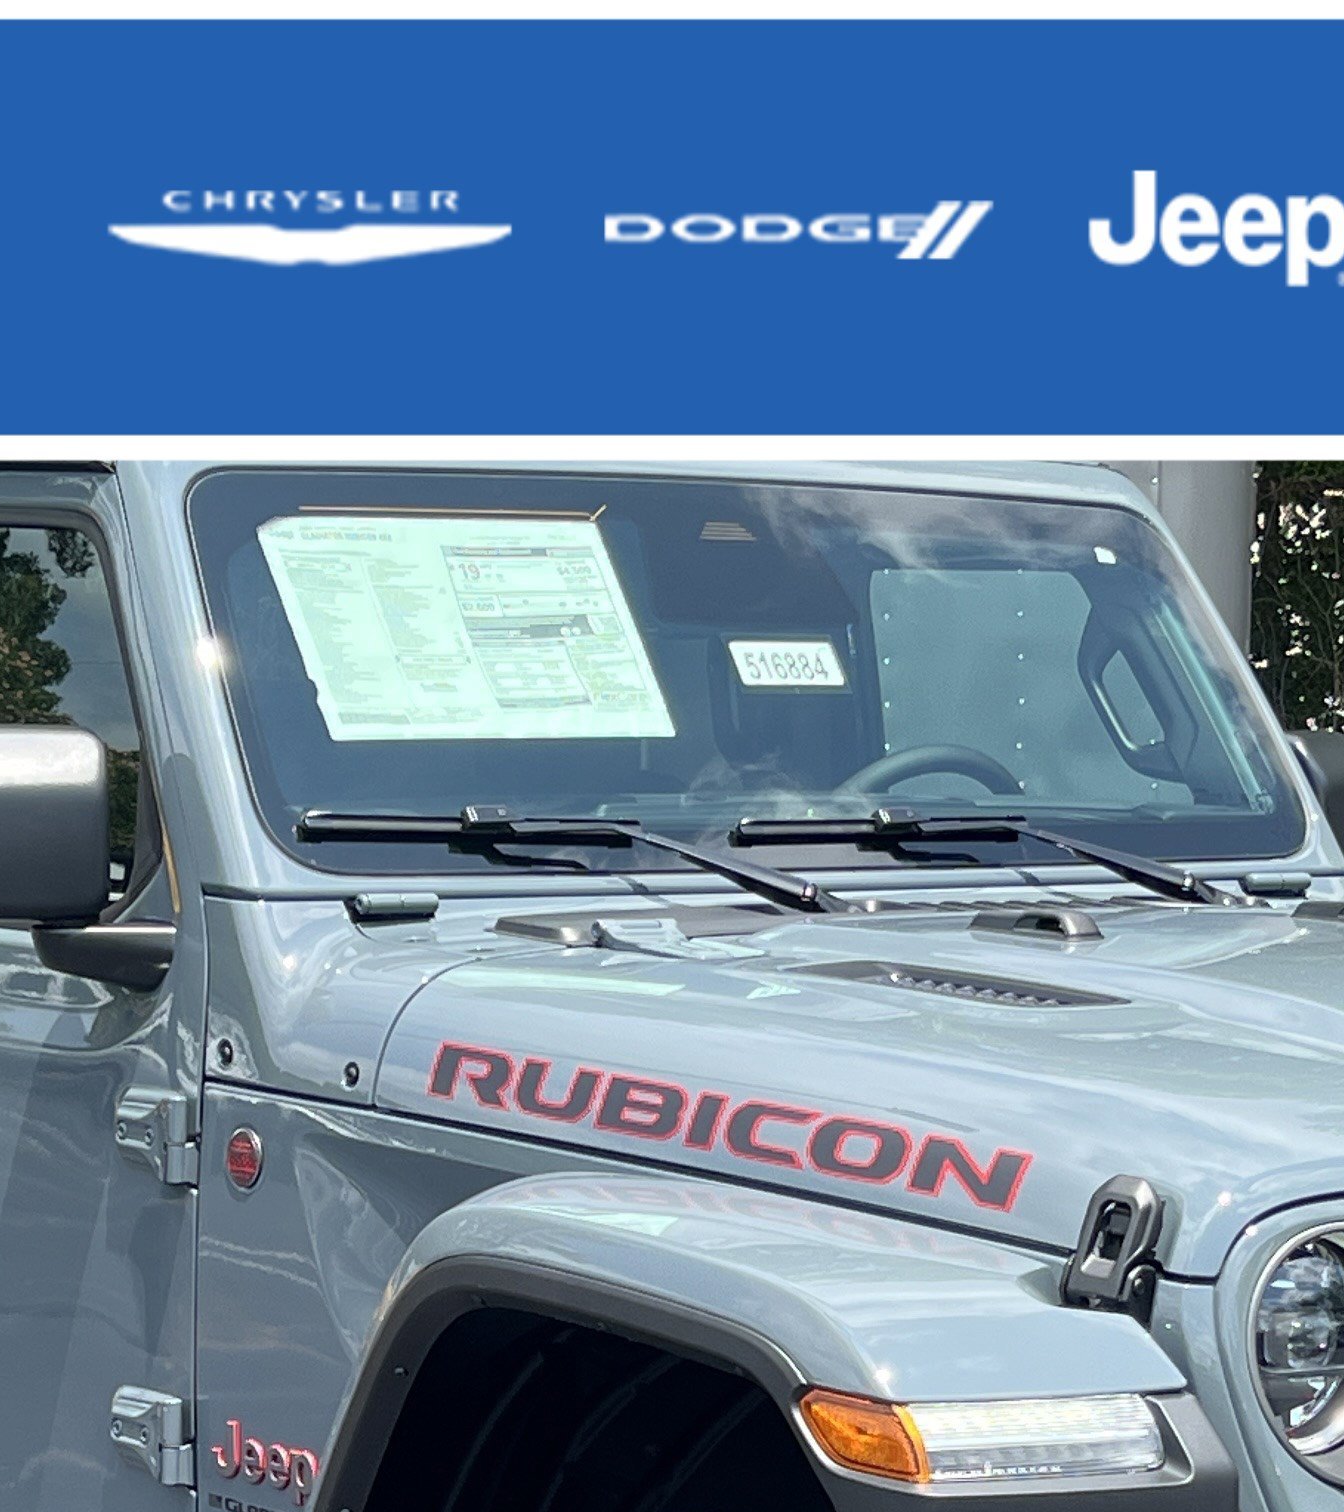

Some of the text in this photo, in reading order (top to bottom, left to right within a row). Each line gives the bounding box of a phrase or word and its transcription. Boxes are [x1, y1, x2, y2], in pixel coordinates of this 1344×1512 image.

[743, 651, 828, 681] 516884
[425, 1040, 1034, 1213] RUBICON
[211, 1416, 320, 1507] Jeep
